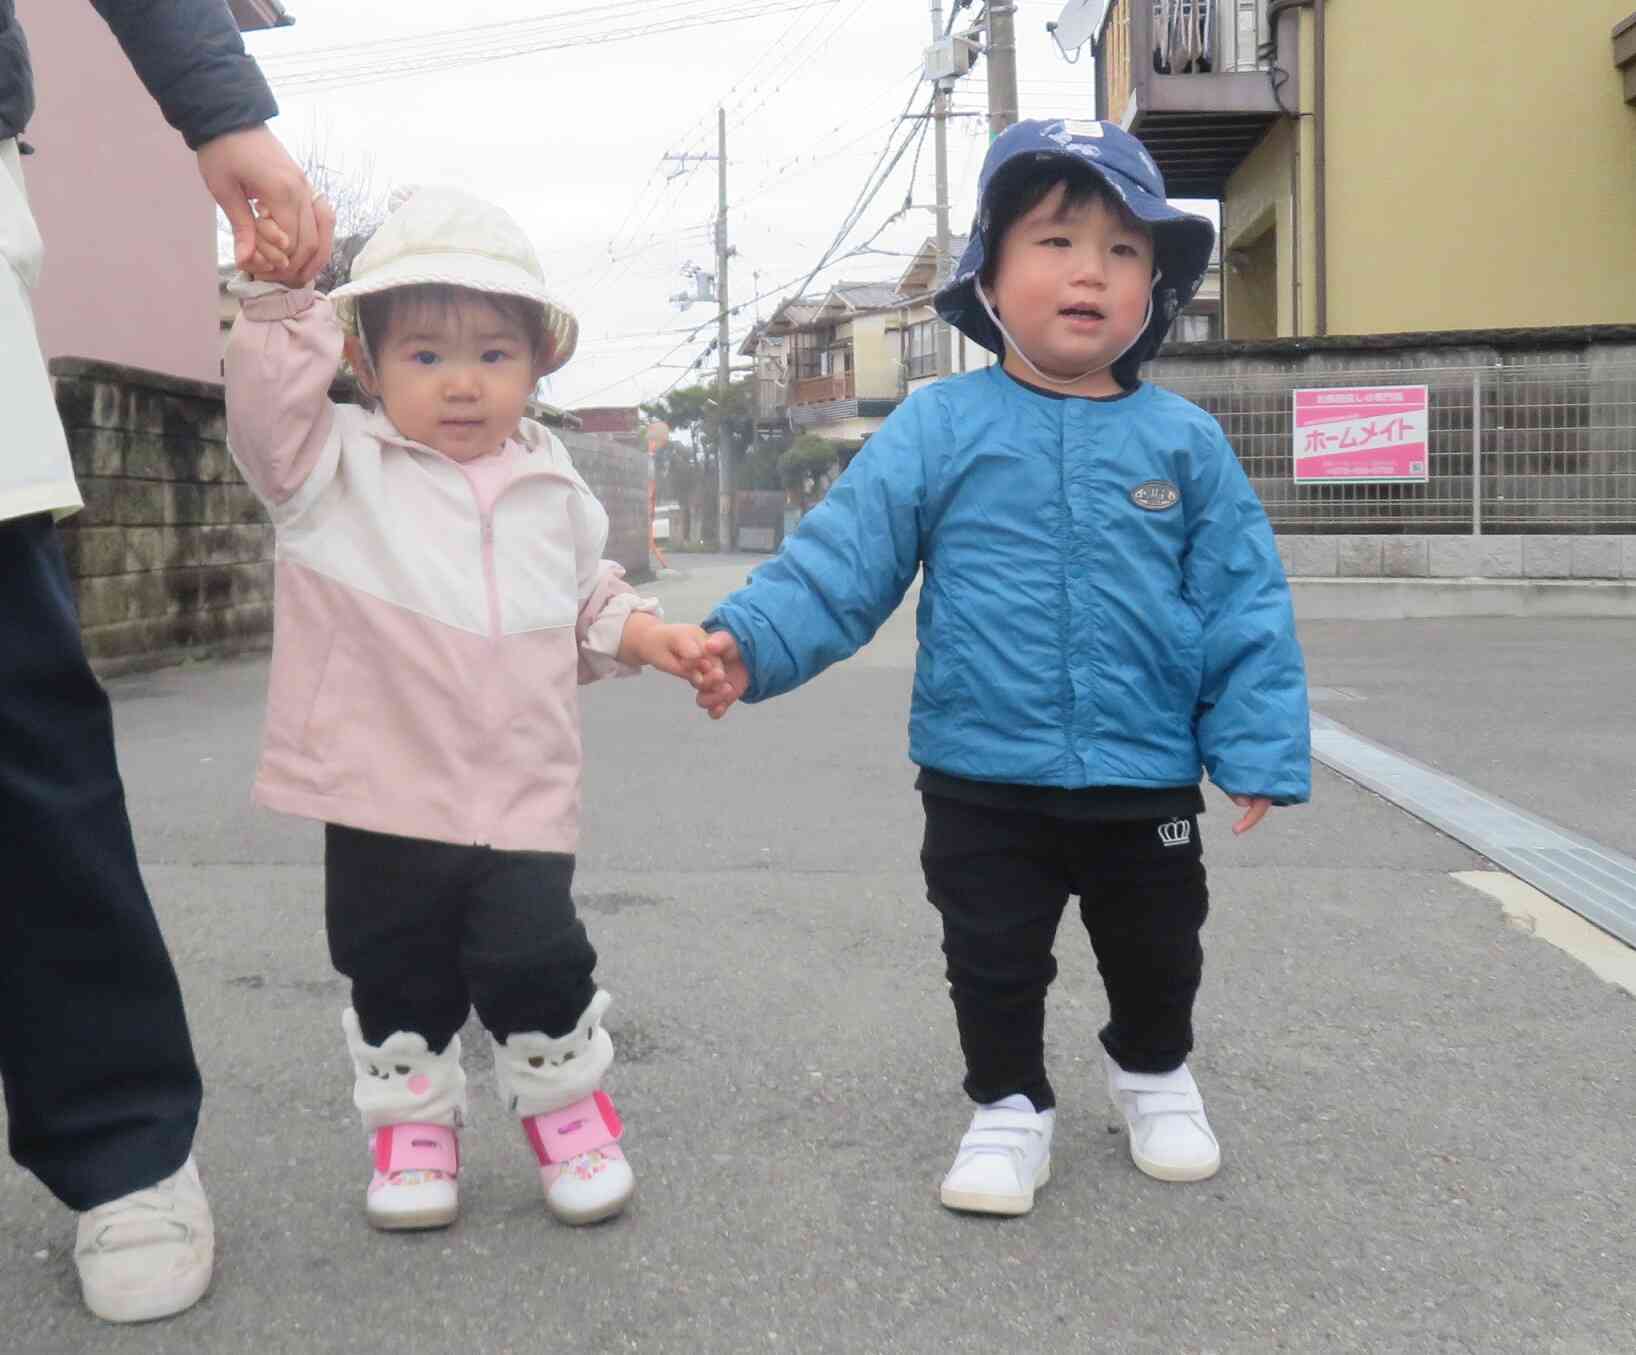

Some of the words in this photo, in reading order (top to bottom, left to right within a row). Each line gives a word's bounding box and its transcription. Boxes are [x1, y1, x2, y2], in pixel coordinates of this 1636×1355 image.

[1305, 417, 1415, 452] ホームメイト
